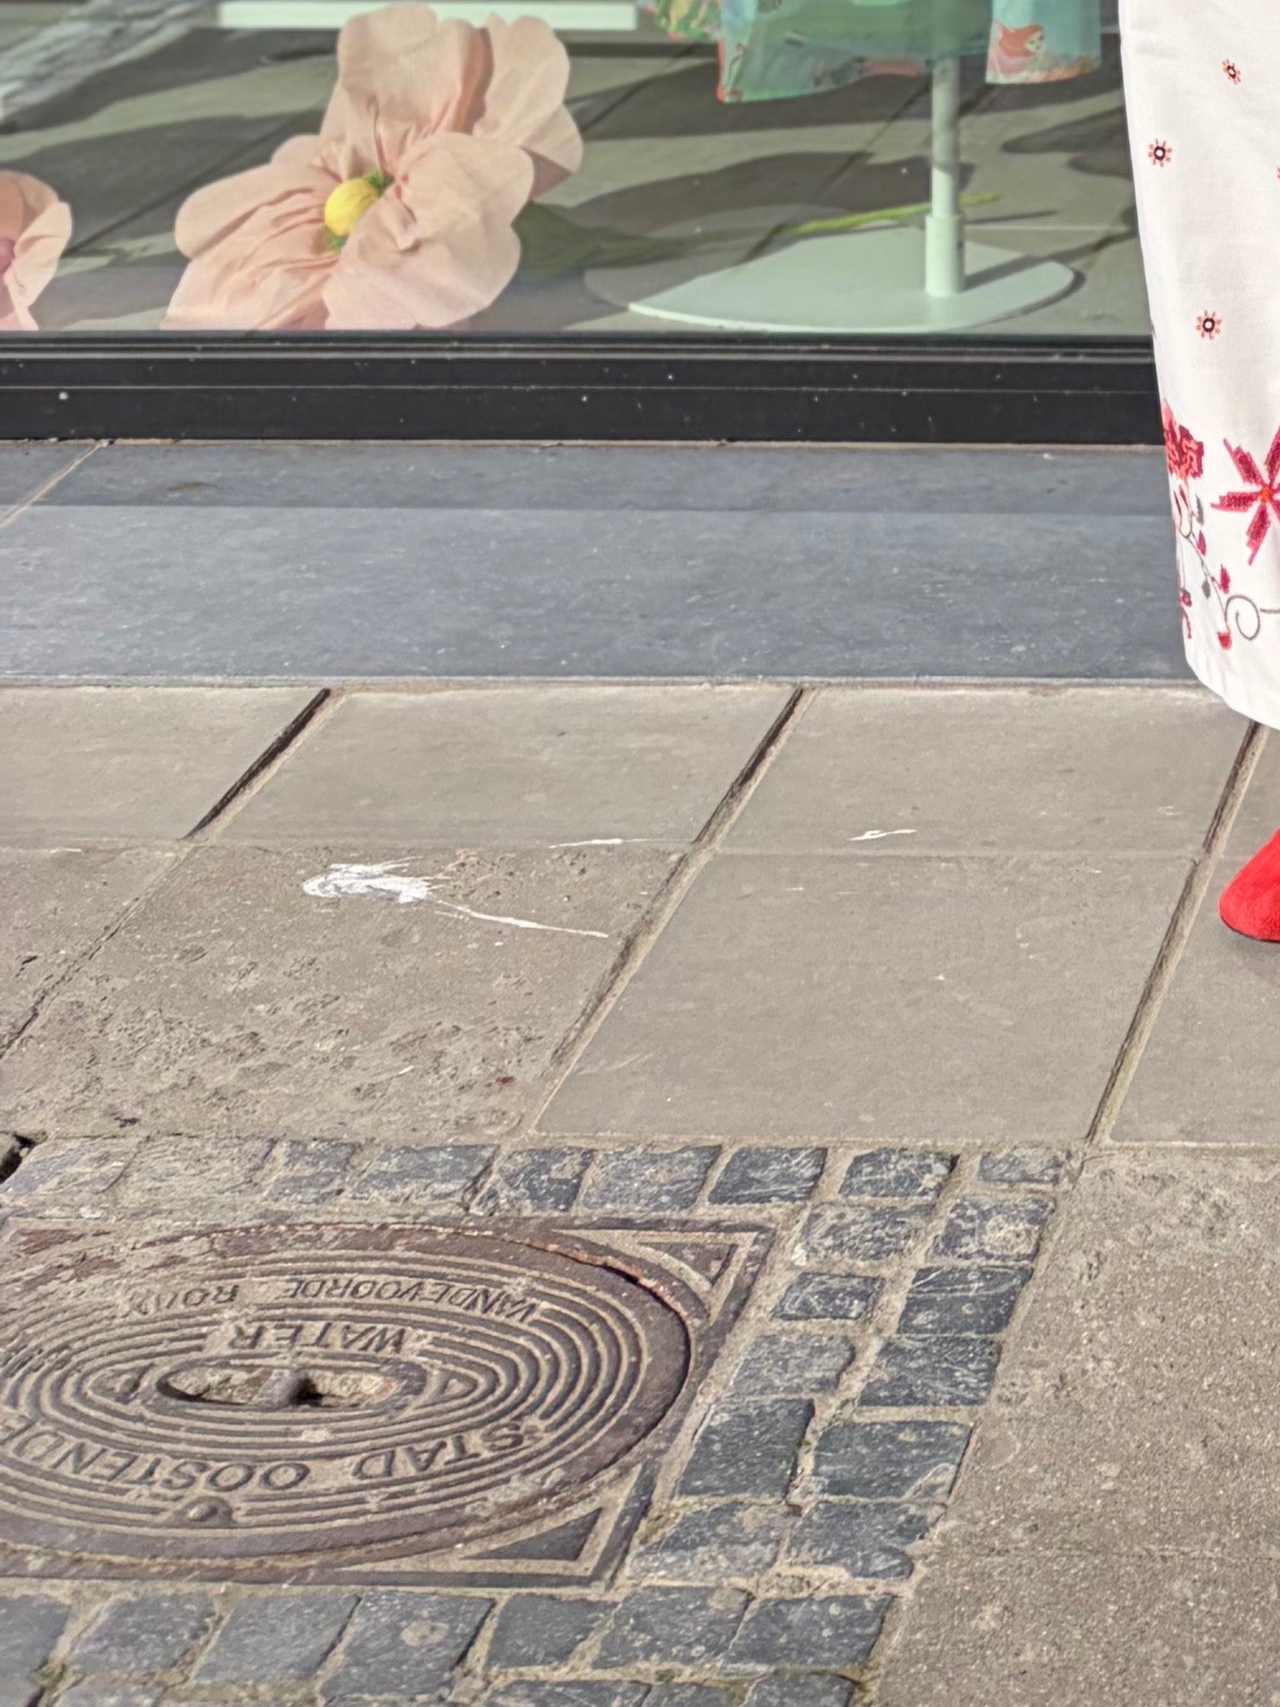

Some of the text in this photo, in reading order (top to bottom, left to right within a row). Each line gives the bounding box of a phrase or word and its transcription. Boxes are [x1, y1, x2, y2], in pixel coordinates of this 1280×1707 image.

[280, 1278, 537, 1323] VANDEVOORDE
[229, 1321, 405, 1354] WATER
[351, 1421, 525, 1480] STAD
